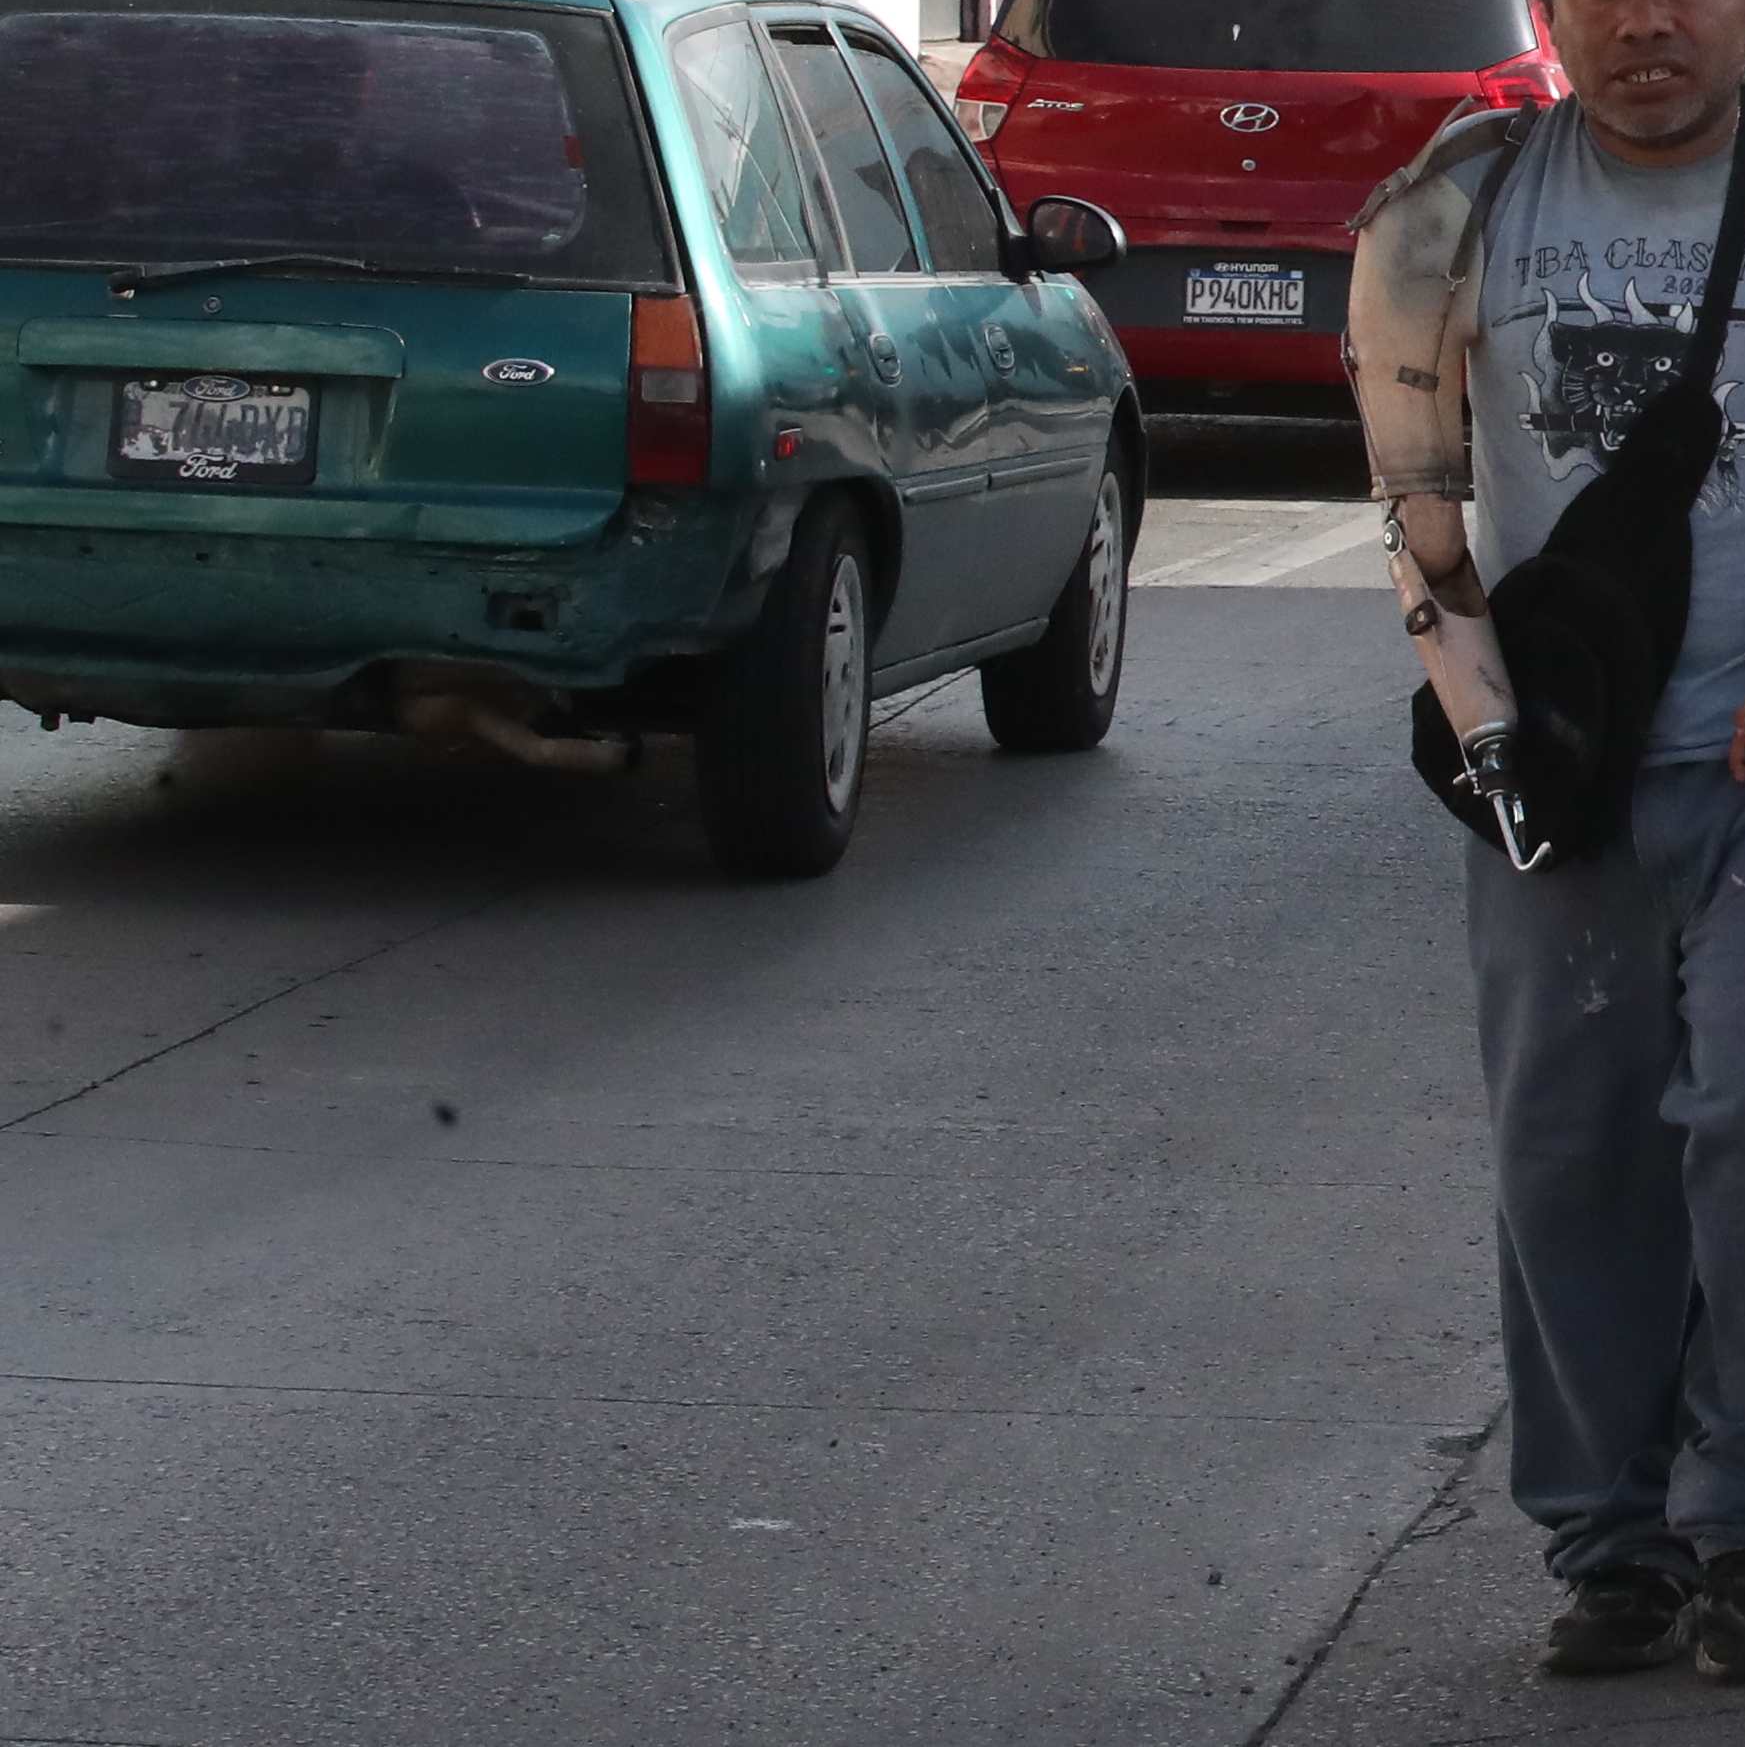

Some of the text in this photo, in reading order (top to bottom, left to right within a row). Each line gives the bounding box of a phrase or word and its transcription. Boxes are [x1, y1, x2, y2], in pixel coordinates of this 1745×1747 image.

[1231, 262, 1280, 273] HYUNDAI
[1191, 279, 1299, 311] P940KHC
[179, 452, 238, 480] Ford
